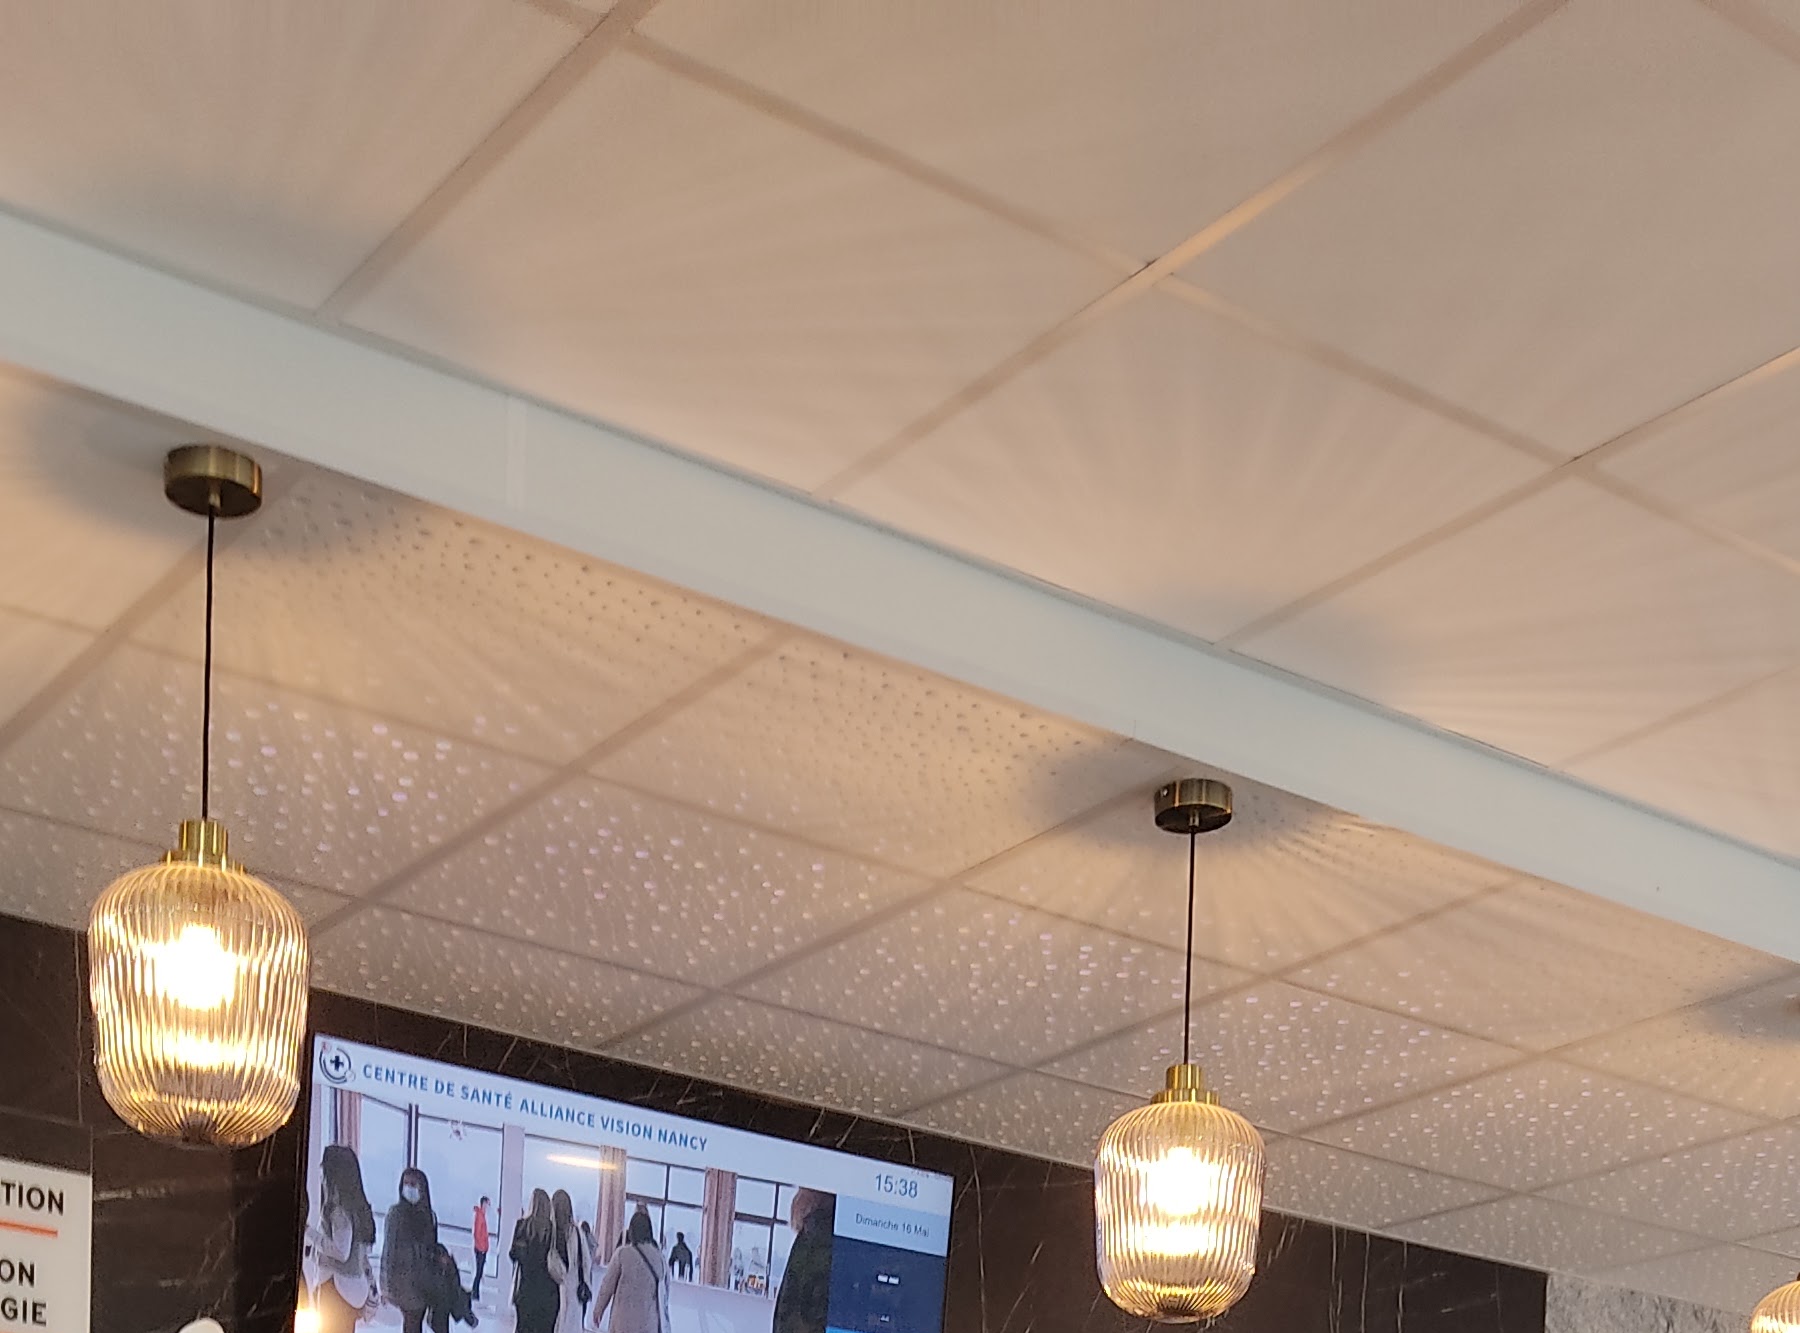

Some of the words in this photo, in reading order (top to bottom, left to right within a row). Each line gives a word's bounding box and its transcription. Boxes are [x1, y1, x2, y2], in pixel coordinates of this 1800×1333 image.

[363, 1063, 428, 1092] CENTRE
[434, 1079, 455, 1098] DE
[460, 1084, 513, 1110] SANTÉ
[519, 1099, 595, 1128] ALLIANCE
[600, 1115, 653, 1140] VISION
[657, 1128, 708, 1152] NANCY
[0, 1181, 64, 1216] TION
[876, 1173, 918, 1199] 15:38
[855, 1213, 899, 1231] Dimanche
[913, 1224, 930, 1238] Mai
[0, 1297, 47, 1327] GIE
